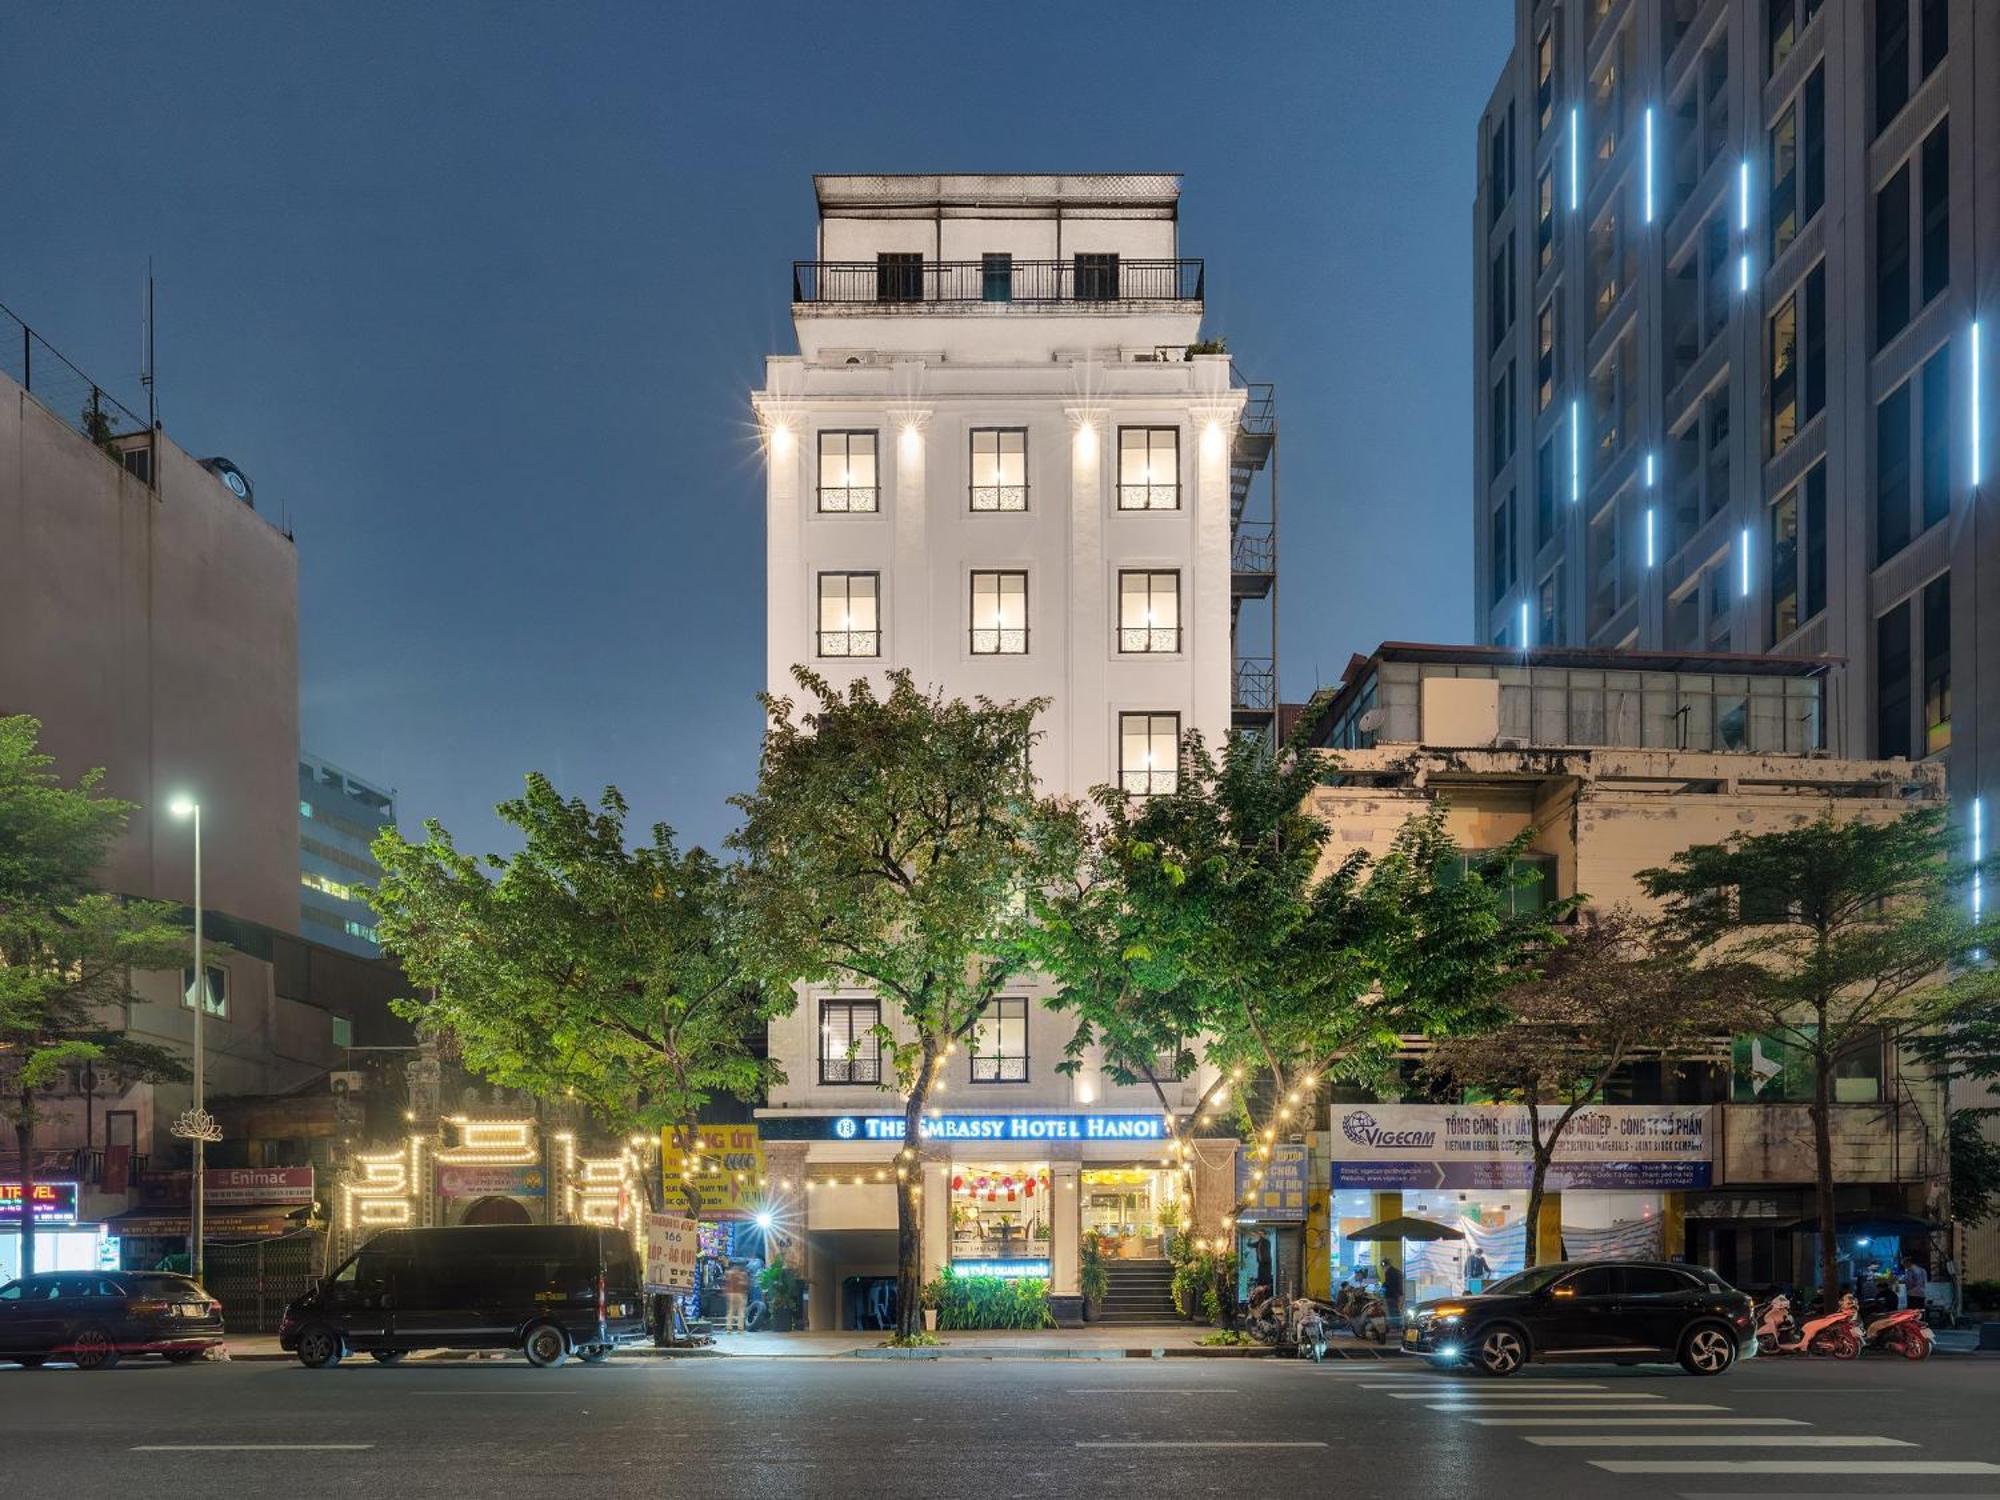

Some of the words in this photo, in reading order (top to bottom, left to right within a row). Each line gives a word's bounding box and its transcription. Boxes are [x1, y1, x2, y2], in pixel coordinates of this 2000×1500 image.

[866, 1119, 906, 1138] THE
[1011, 1119, 1080, 1137] HOTEL
[1087, 1119, 1158, 1137] HANOI
[231, 1171, 287, 1185] Enimac
